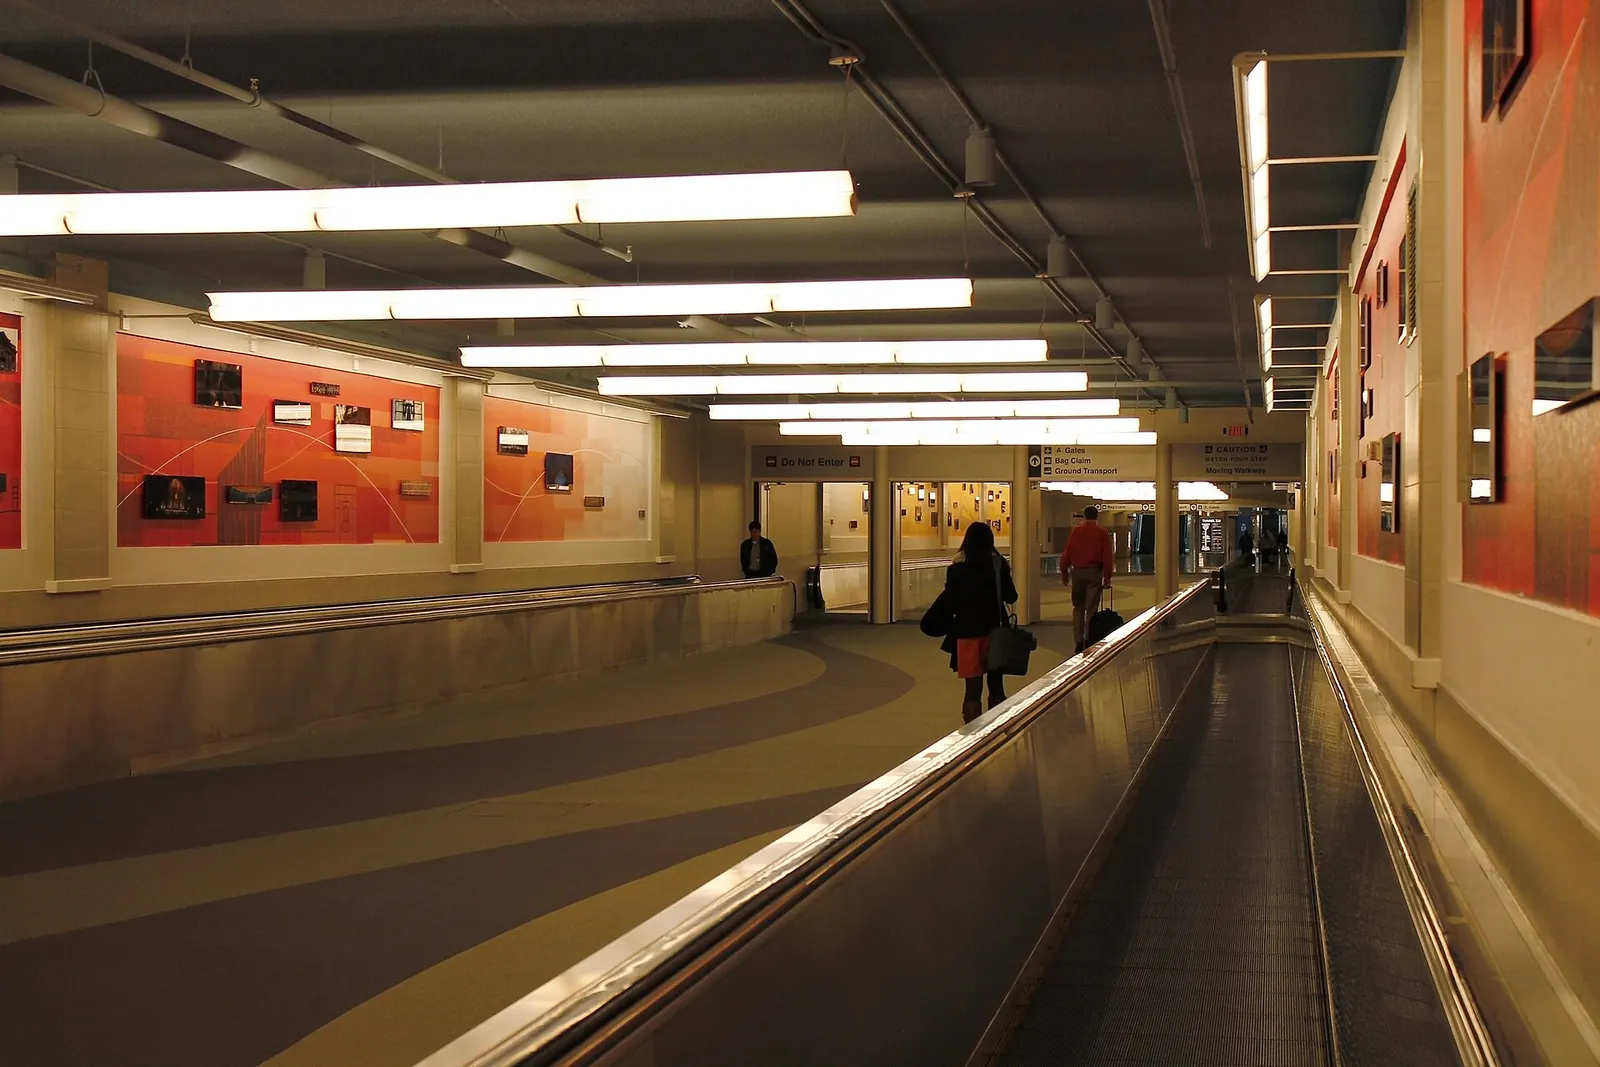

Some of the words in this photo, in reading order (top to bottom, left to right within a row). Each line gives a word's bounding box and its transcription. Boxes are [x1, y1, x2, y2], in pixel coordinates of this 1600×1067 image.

[1229, 425, 1243, 436] EXIT
[781, 458, 795, 466] Do
[798, 458, 815, 466] Not
[818, 458, 844, 466] Enter
